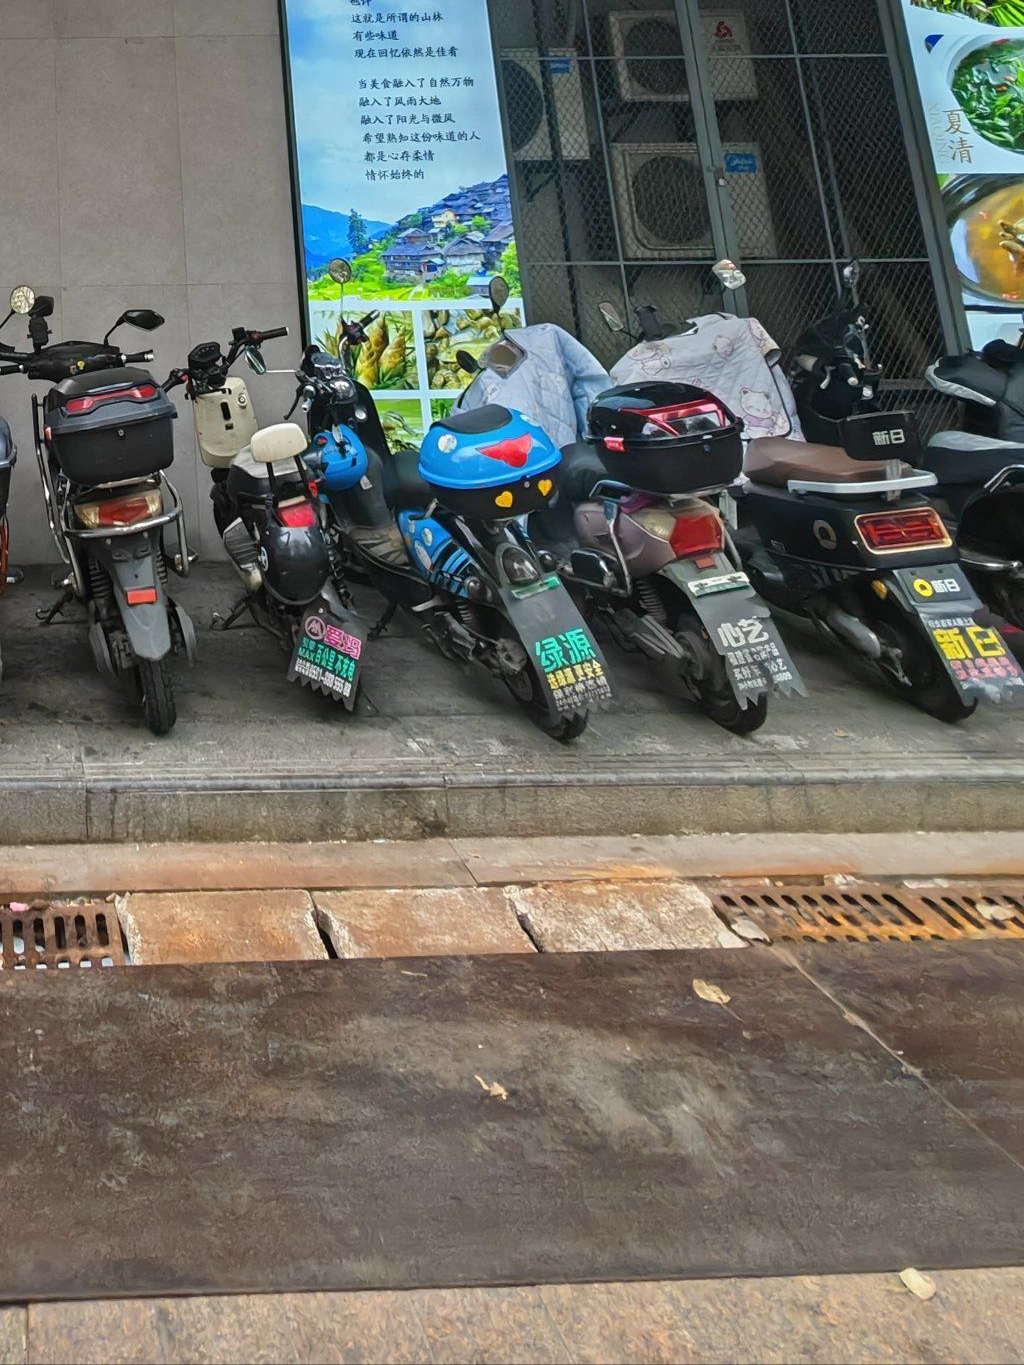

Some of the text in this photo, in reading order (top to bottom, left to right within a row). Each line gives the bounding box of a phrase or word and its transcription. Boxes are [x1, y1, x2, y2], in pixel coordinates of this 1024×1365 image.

[352, 12, 444, 24] 这就是所谓的山林
[353, 30, 399, 42] 有些味道
[358, 76, 474, 89] 当美食融入了自然万物
[358, 95, 442, 107] 融入了风雨大地
[360, 113, 456, 125] 融入了阳光与微风
[363, 131, 481, 144] 希望熟知这份味道的人
[942, 108, 974, 164] 夏清
[364, 150, 435, 162] 都是心存柔情
[365, 169, 424, 181] 情怀始终的
[872, 429, 906, 445] 新日
[930, 579, 961, 593] 新日
[324, 625, 362, 660] 爱玛
[535, 628, 596, 673] 绿源
